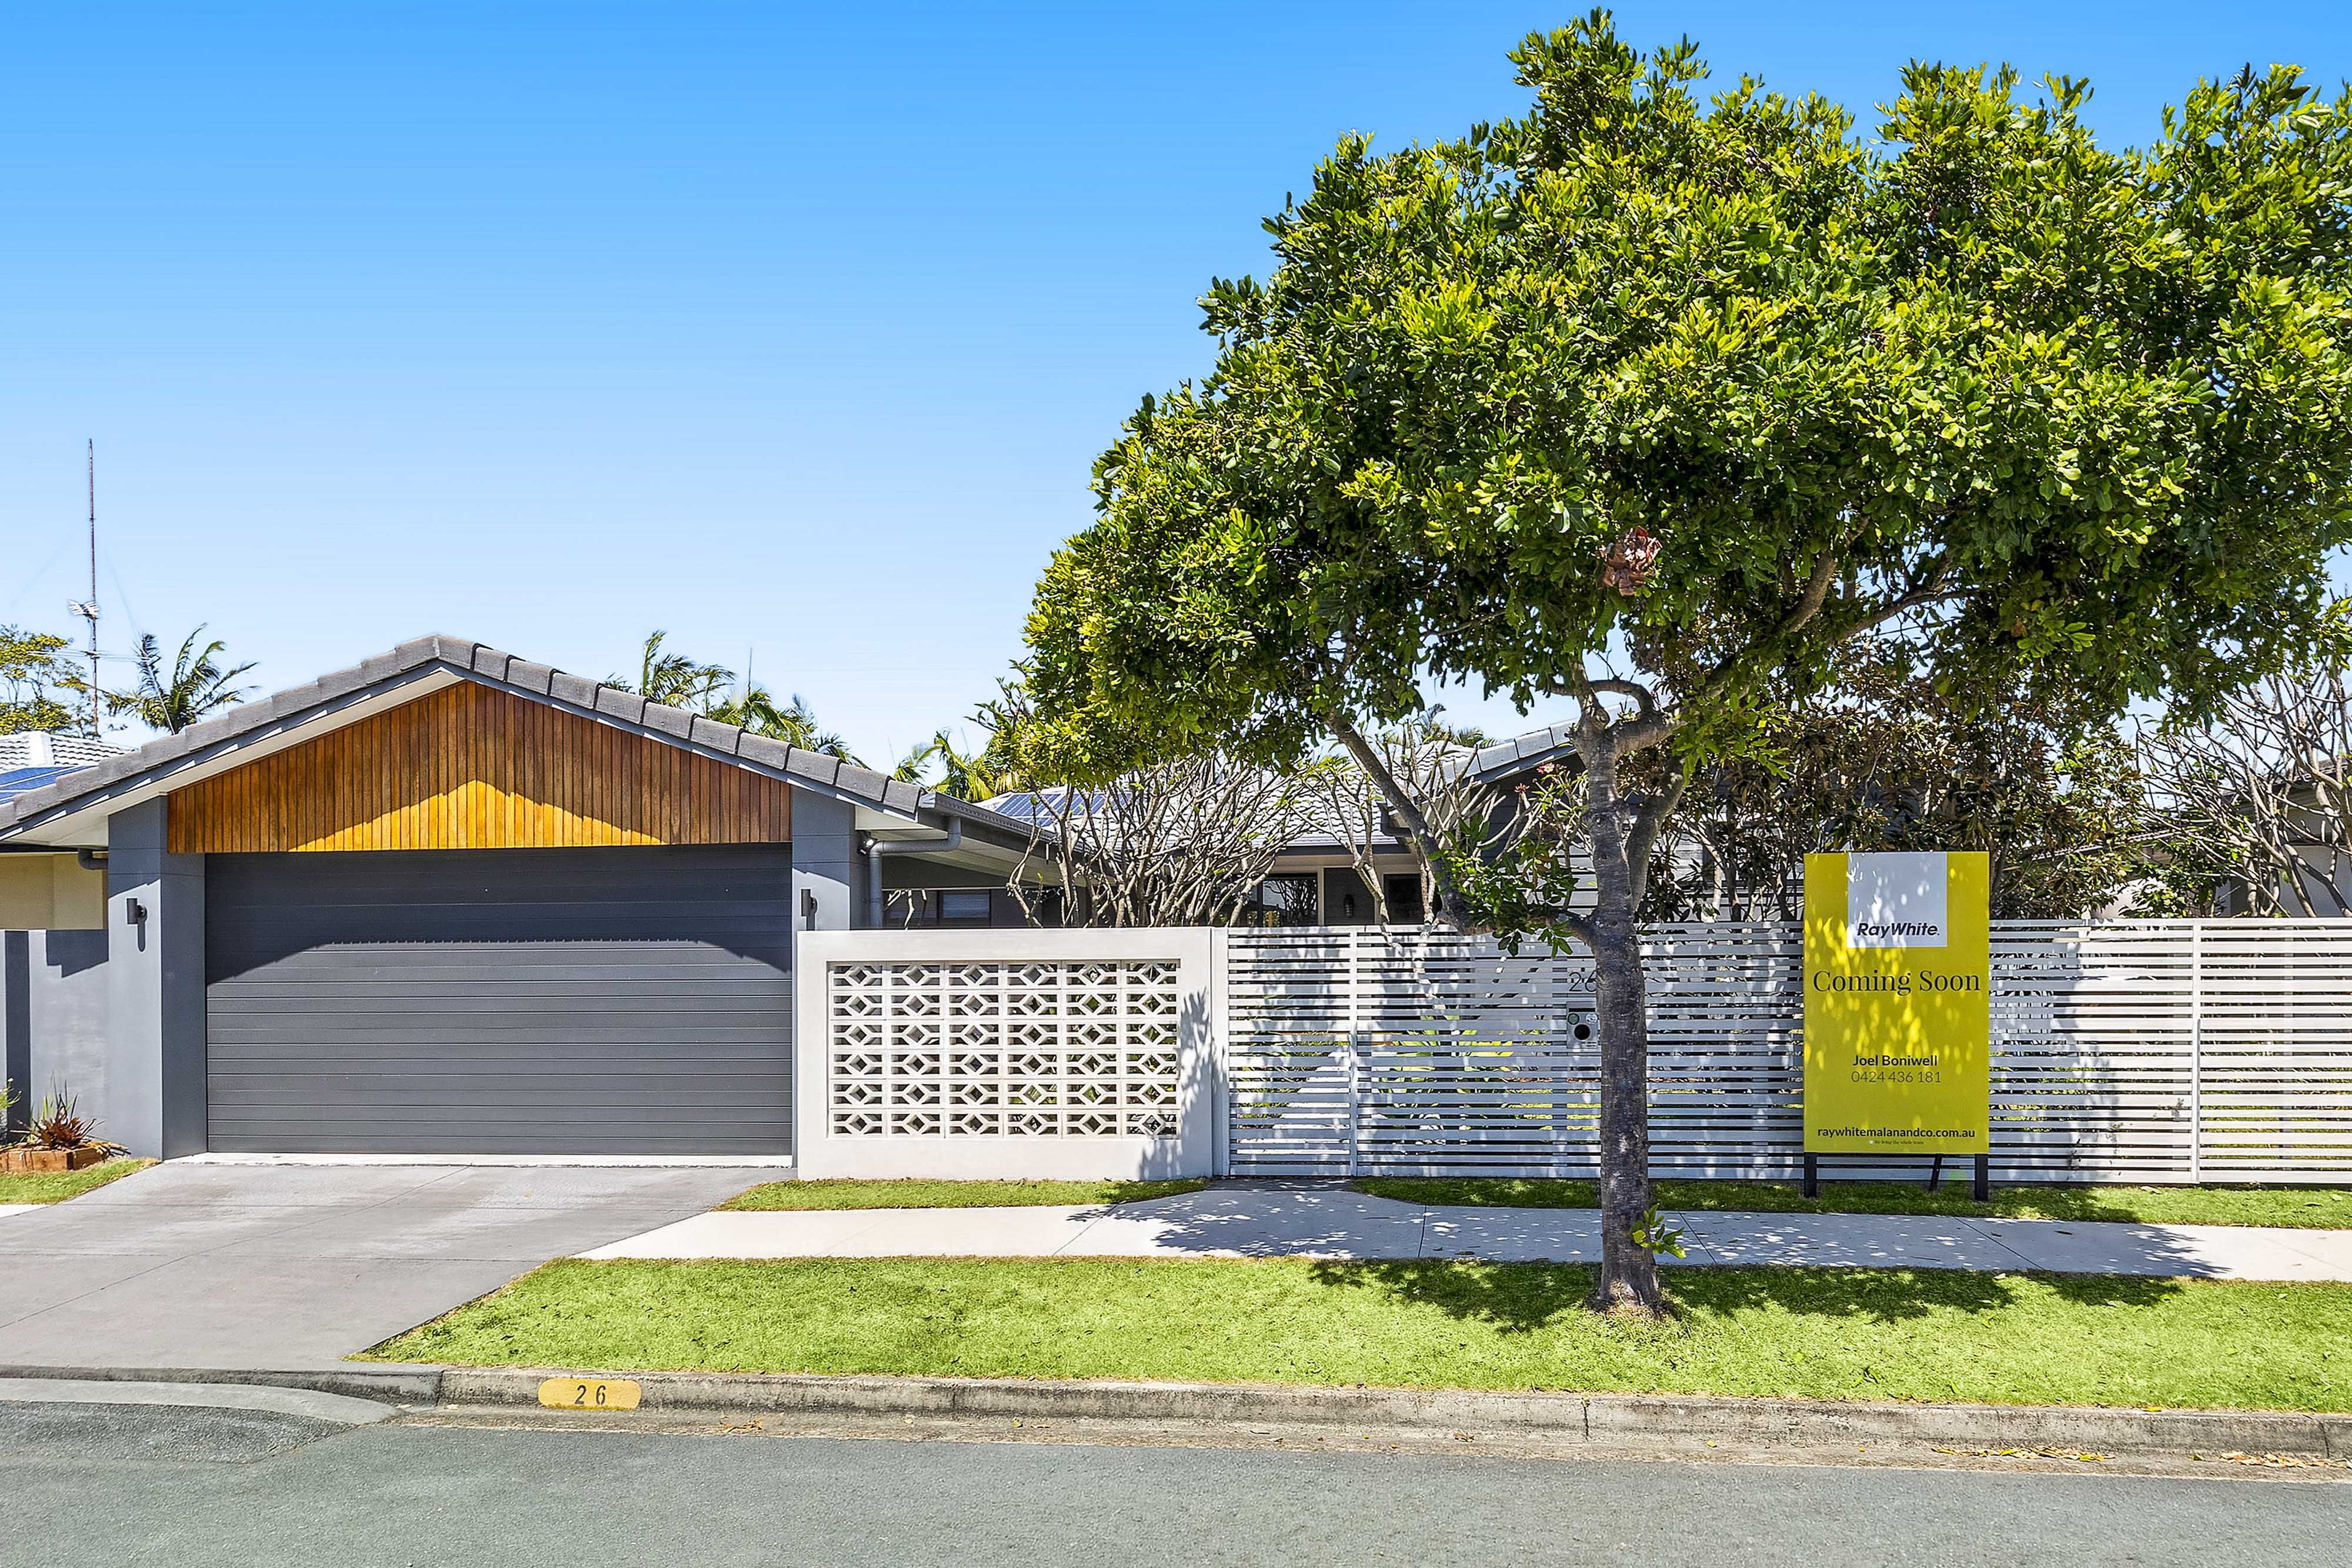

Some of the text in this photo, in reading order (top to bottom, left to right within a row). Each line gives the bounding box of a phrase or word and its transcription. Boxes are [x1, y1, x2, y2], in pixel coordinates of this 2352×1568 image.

[1569, 970, 1596, 992] 26
[1813, 969, 1980, 996] Coming Soon
[1853, 1055, 1937, 1066] Joel Boniwell
[1851, 1071, 1942, 1082] 0424 436 181
[1818, 1126, 1975, 1138] raywhitemalanandco.com.au
[574, 1385, 606, 1405] 26
